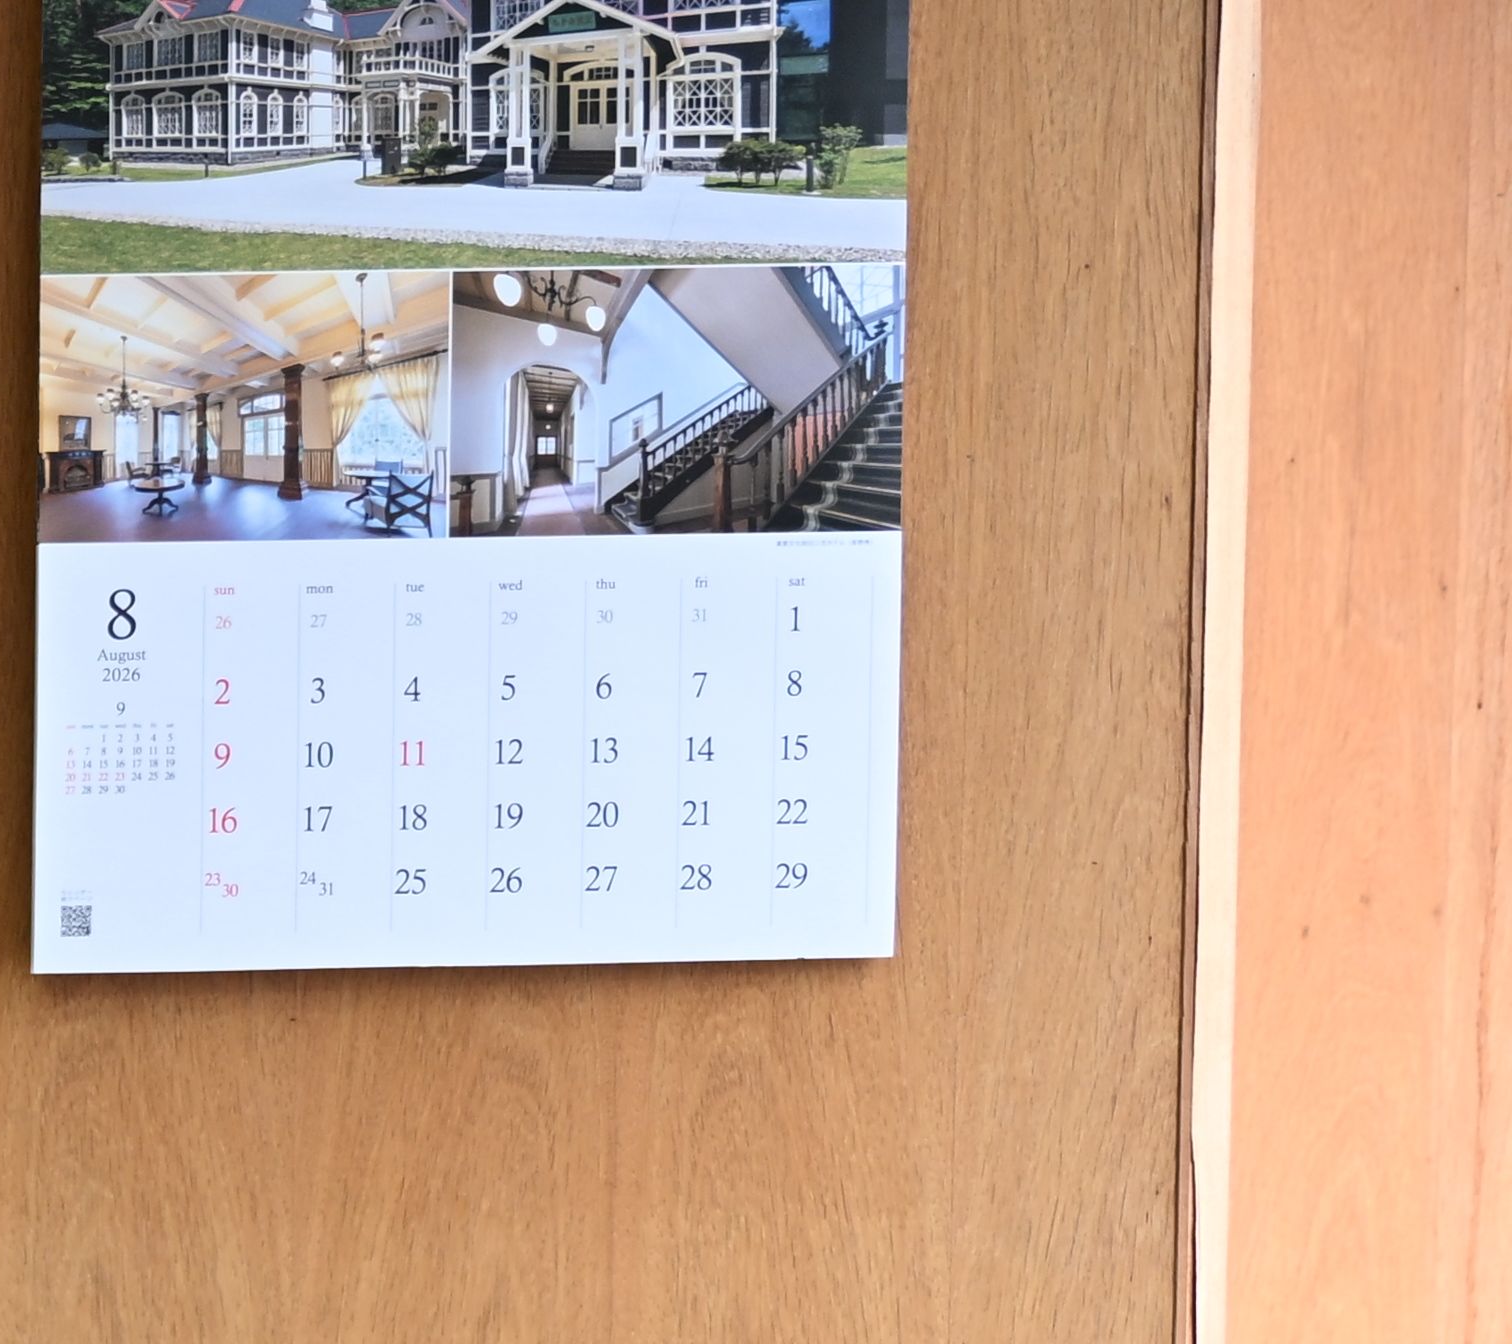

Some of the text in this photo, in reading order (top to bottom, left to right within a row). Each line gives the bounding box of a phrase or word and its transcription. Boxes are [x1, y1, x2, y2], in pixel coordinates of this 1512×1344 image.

[214, 576, 806, 596] sun mon tue wed thu fri sat
[107, 588, 137, 641] 8
[215, 606, 800, 632] 26 27 28 29 30 31 1
[96, 648, 146, 665] August
[102, 667, 141, 682] 2026
[214, 670, 802, 705] 2 3 4 5 6 7 8
[116, 701, 126, 716] 9
[214, 734, 809, 769] 9 10 11 12 13 14 15
[210, 798, 808, 834] 16 17 18 19 20 21 22
[204, 862, 808, 898] 23 30 24 31 25 26 27 28 29
